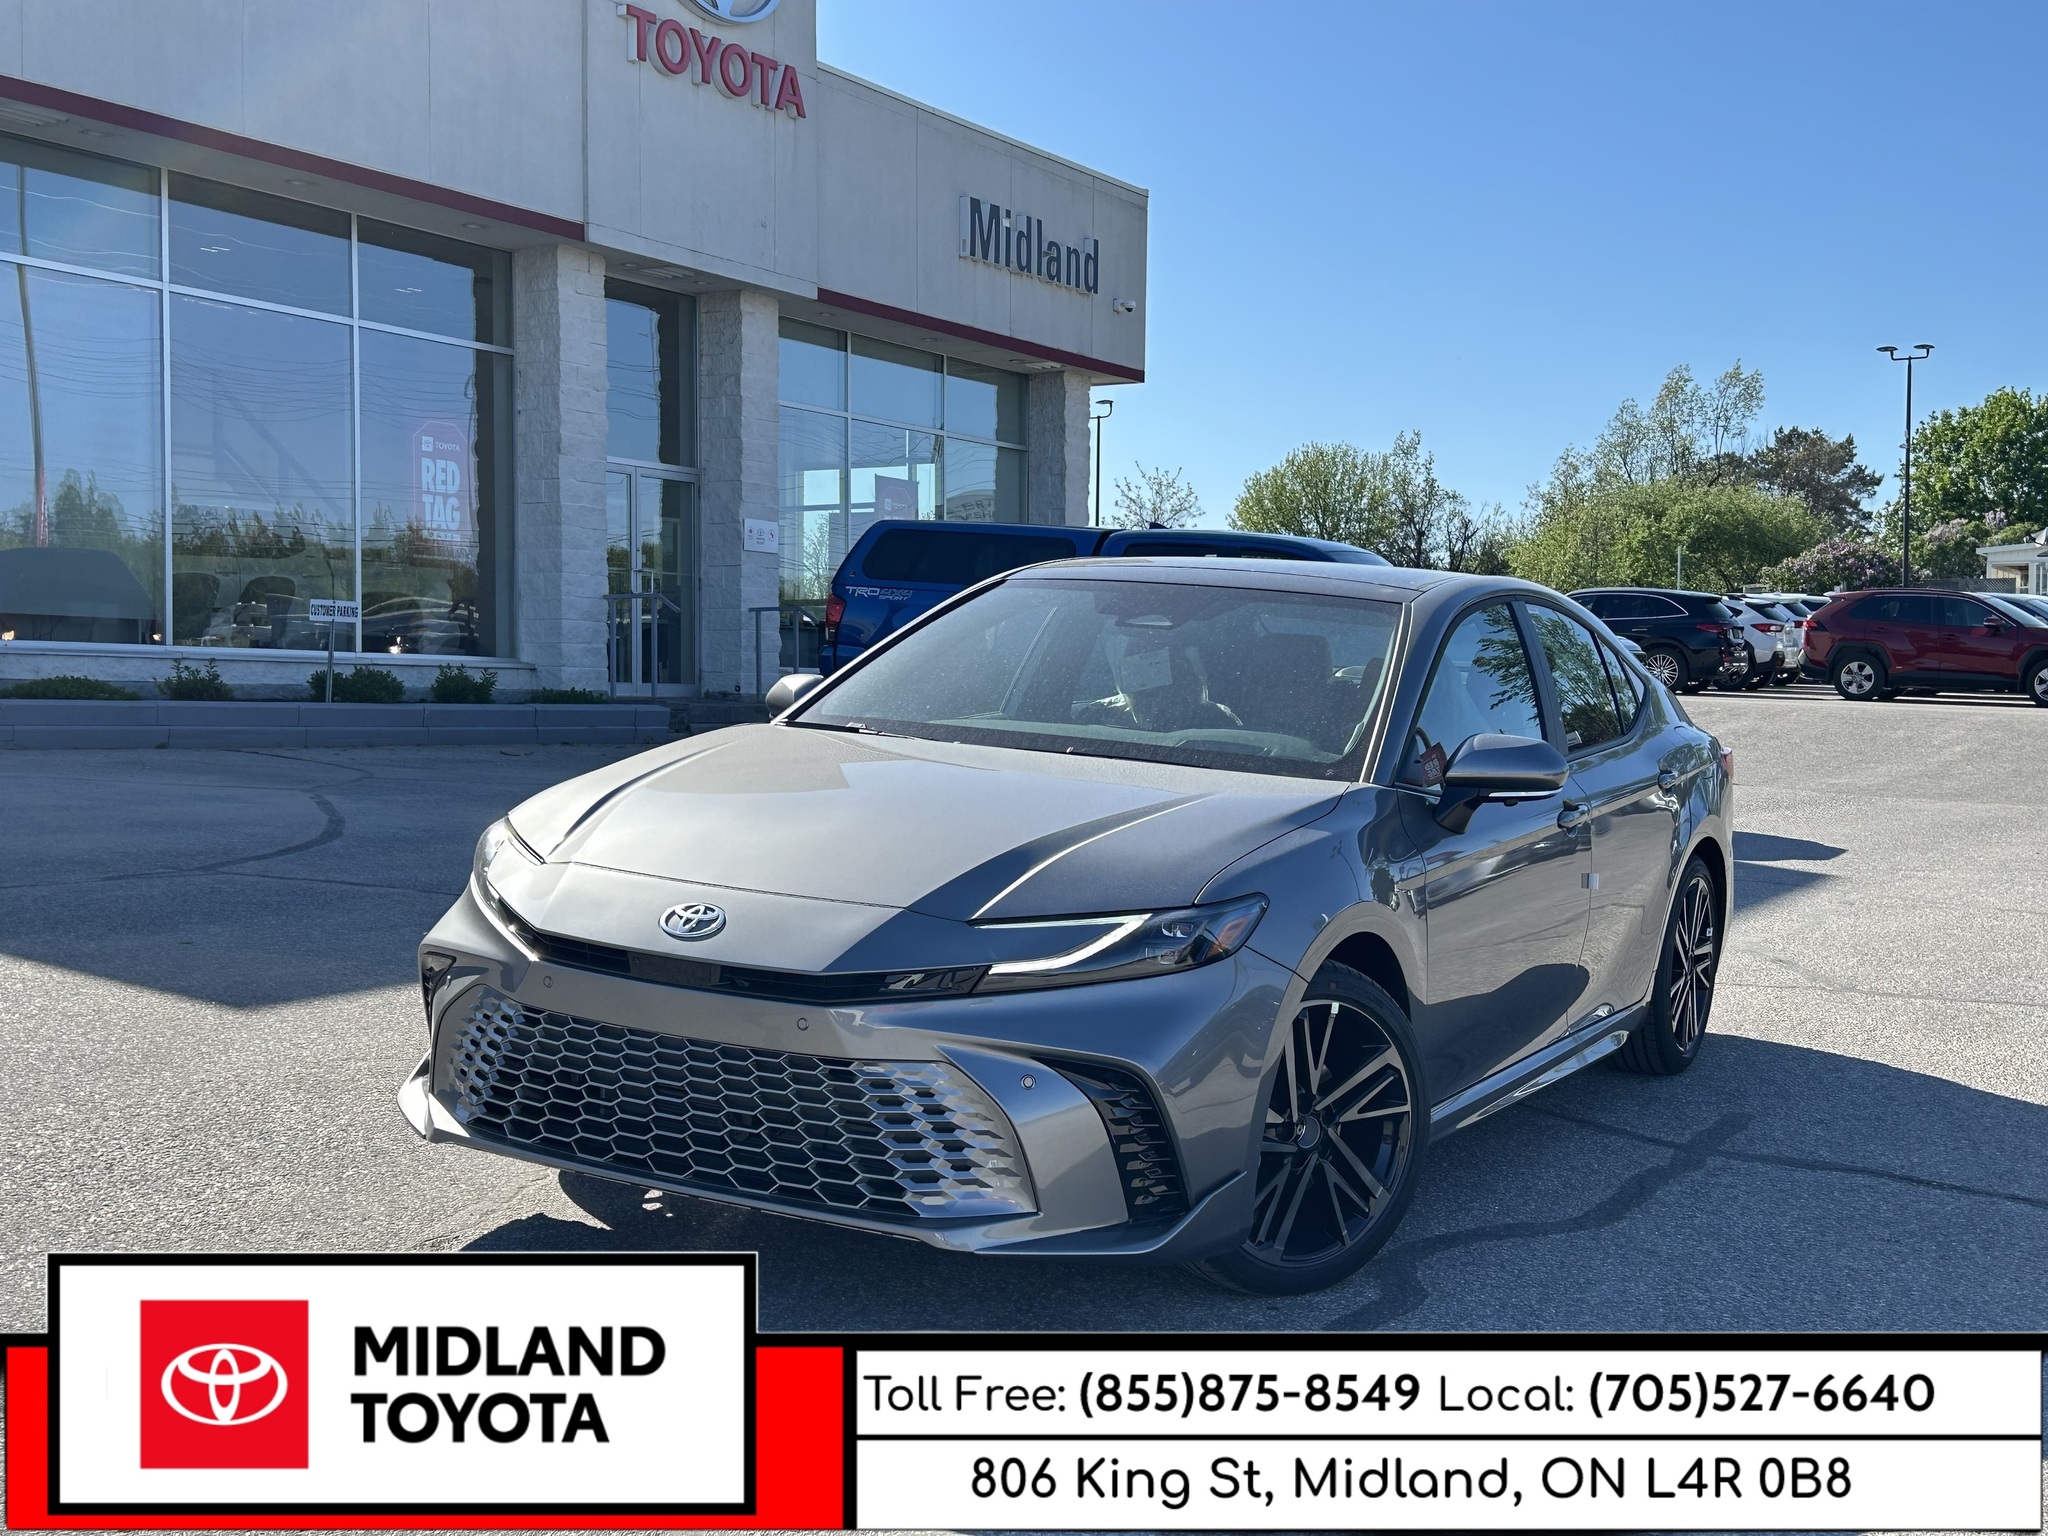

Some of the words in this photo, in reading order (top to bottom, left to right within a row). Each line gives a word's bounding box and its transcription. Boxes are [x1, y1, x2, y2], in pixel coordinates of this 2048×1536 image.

[626, 4, 806, 118] TOYOTA
[969, 196, 1099, 294] Midland
[435, 441, 460, 452] TOYOTA
[421, 457, 460, 494] RED
[421, 493, 460, 531] TAG
[311, 604, 336, 617] CUSTOMER
